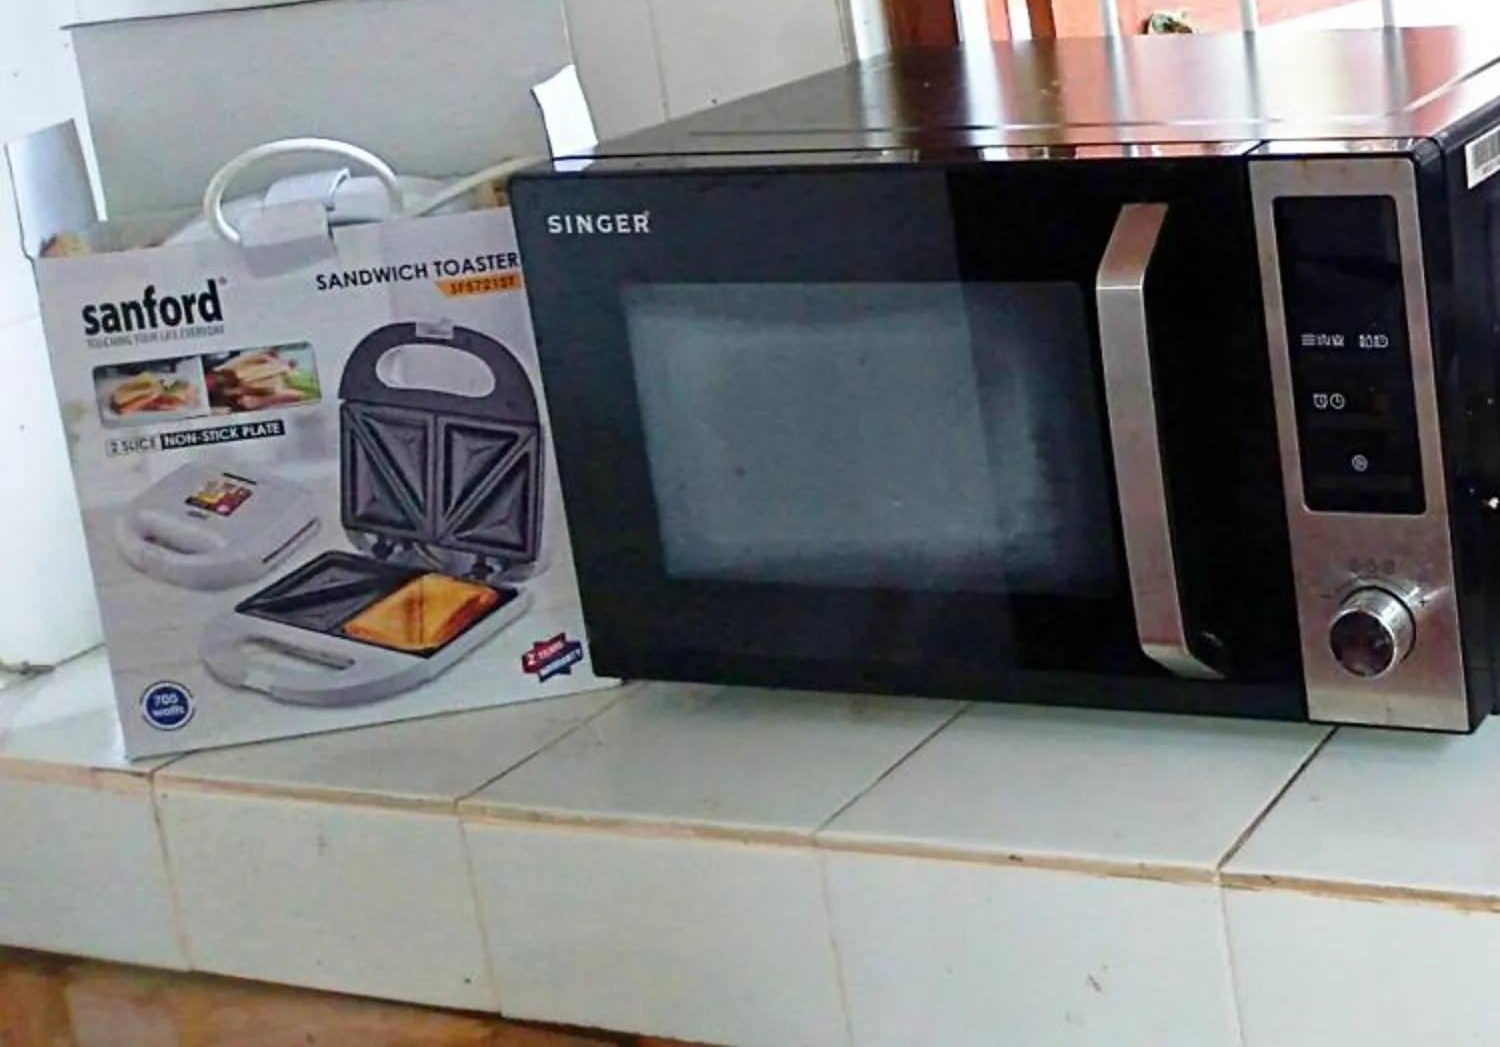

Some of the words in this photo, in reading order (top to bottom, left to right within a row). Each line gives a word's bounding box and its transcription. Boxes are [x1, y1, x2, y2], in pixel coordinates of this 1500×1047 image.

[547, 213, 650, 234] SINGER
[316, 262, 428, 291] SANDWICH
[433, 252, 520, 276] TOASTER
[82, 278, 223, 336] sanford
[164, 425, 239, 448] NON-STICK
[242, 421, 282, 438] PLATE
